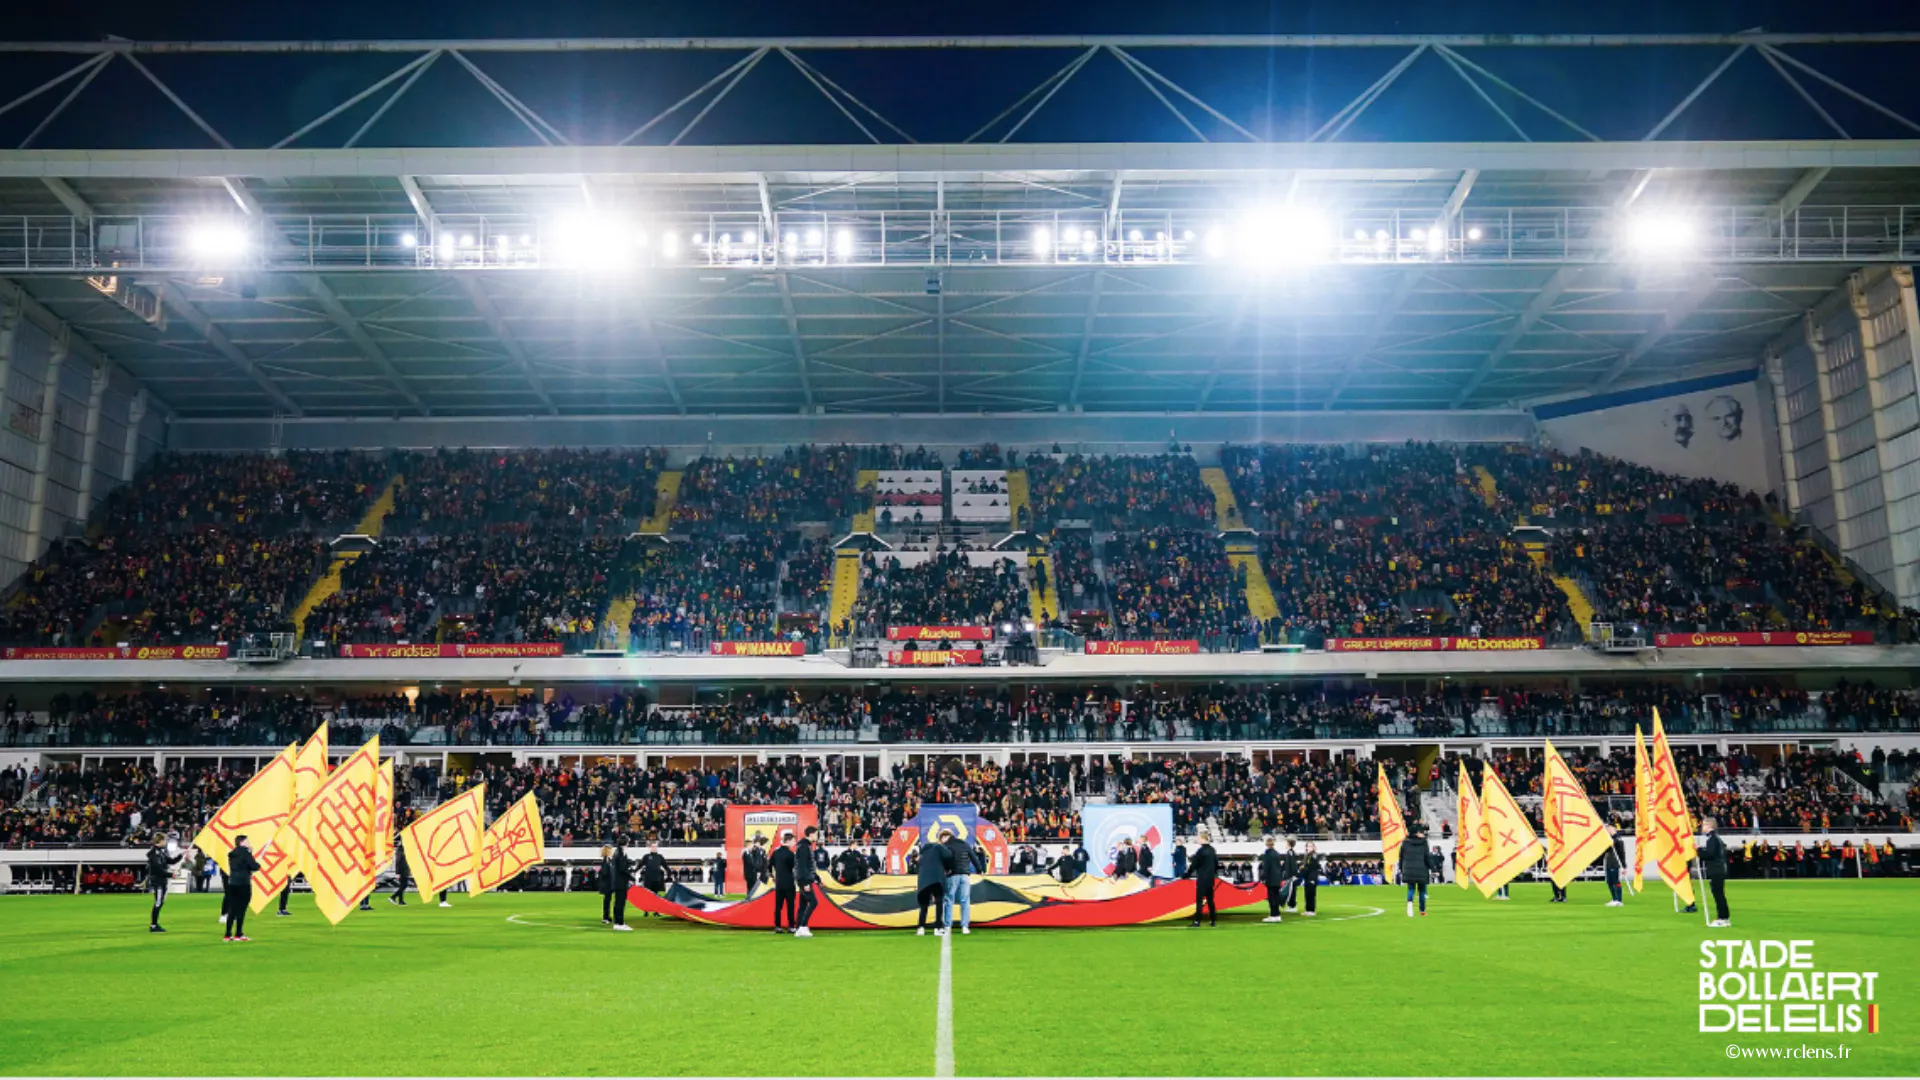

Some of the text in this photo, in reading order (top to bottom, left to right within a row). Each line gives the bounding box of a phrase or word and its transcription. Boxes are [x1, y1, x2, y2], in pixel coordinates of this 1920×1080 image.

[919, 627, 962, 638] Auchan
[735, 642, 792, 656] WINAMAX
[1456, 638, 1540, 649] McDonald's
[387, 644, 440, 657] randstad
